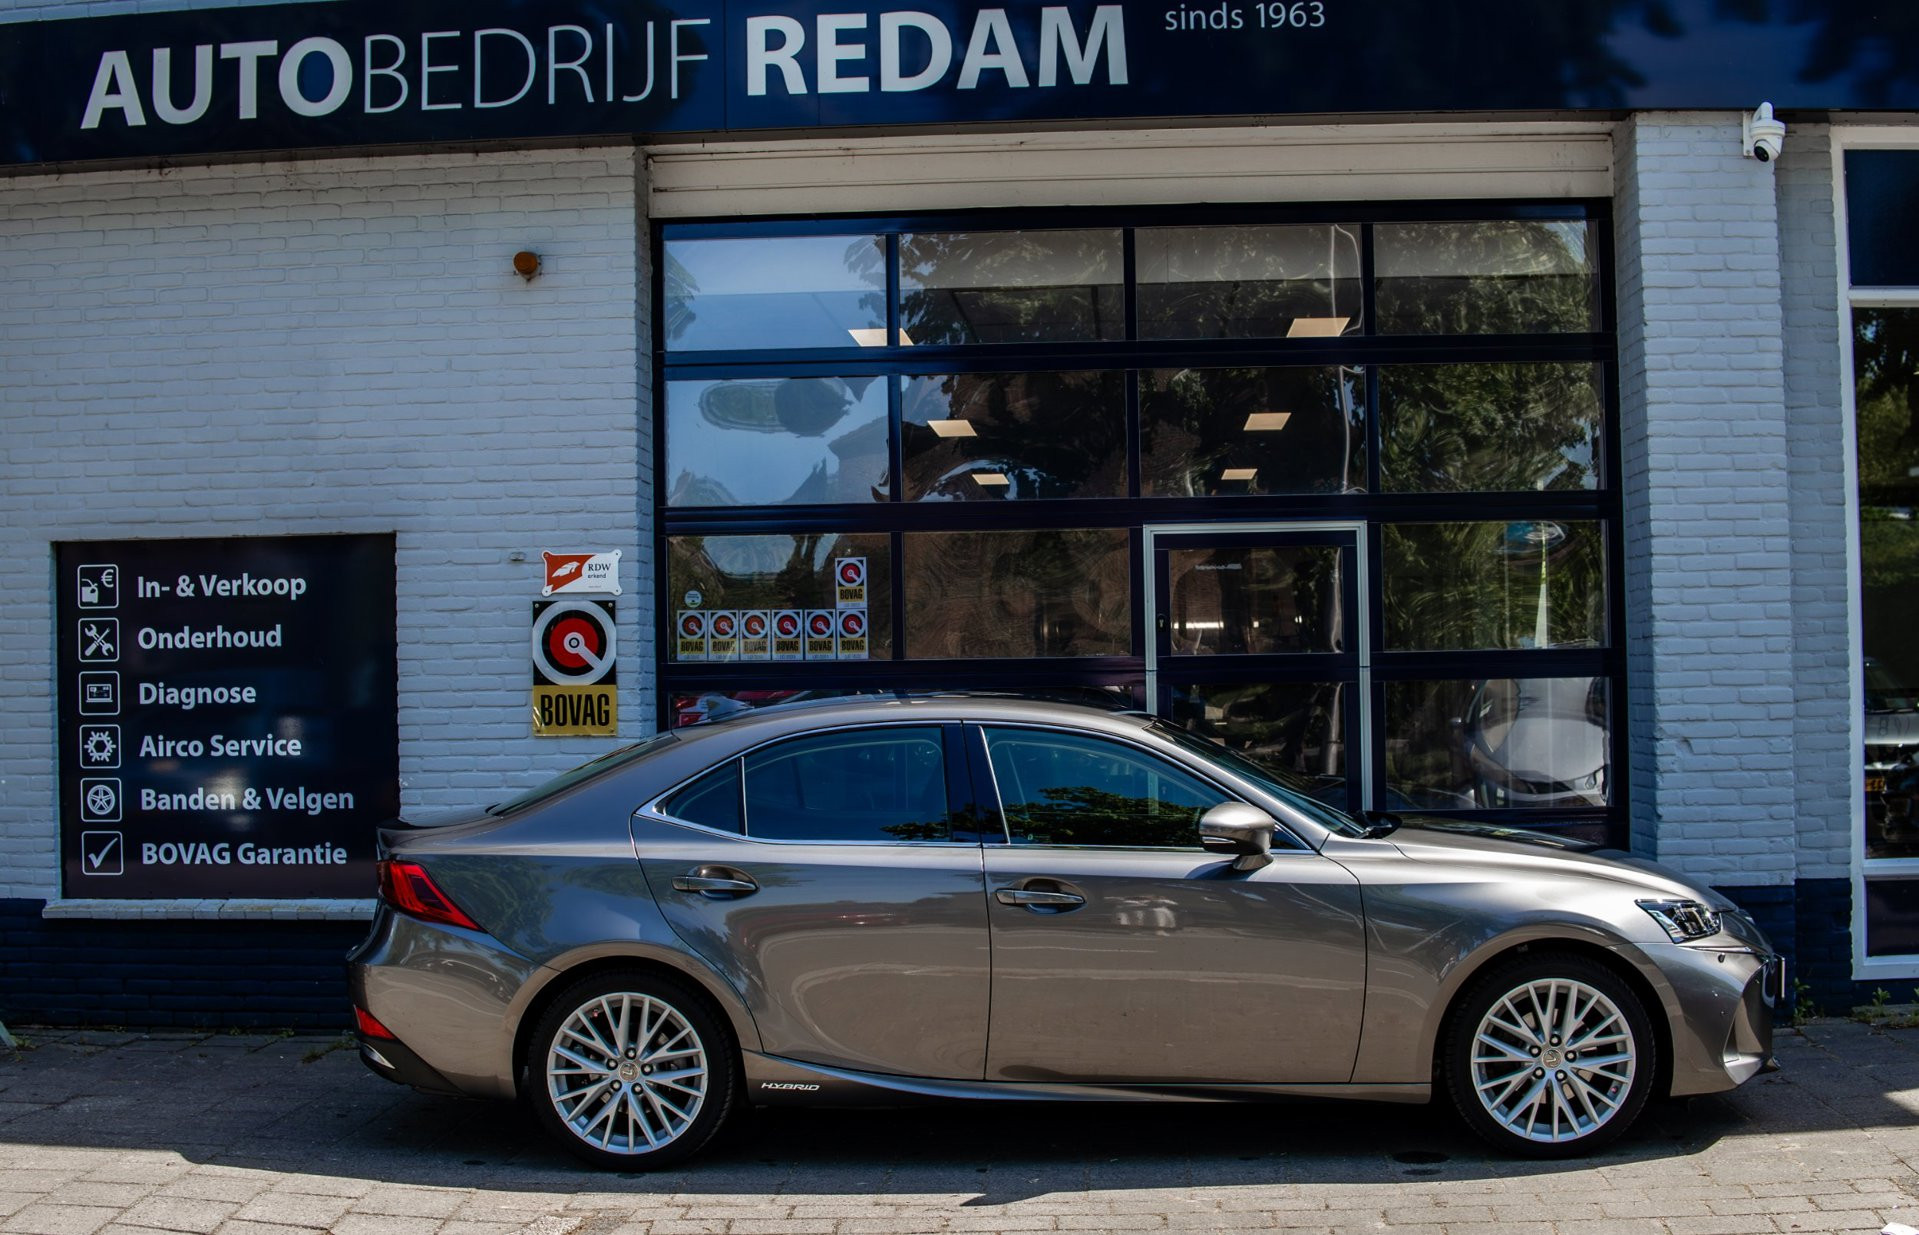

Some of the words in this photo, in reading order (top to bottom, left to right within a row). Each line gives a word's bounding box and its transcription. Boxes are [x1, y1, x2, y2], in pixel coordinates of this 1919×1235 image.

[1165, 2, 1244, 31] sinds
[1255, 1, 1326, 29] 1963
[747, 4, 1129, 97] REDAM
[587, 563, 612, 572] RDW
[137, 576, 170, 598] In-
[175, 575, 195, 598] &
[199, 573, 307, 601] Verkoop
[840, 588, 863, 600] BOVAG
[137, 624, 282, 650] Onderhoud
[809, 640, 832, 651] BOVAG
[841, 639, 864, 651] BOVAG
[139, 682, 257, 710] Diagnose
[540, 693, 610, 727] BOVAG
[139, 735, 204, 758] Airco
[210, 734, 302, 757] Service
[141, 787, 236, 811] Banden
[242, 787, 262, 810] &
[265, 786, 354, 816] Velgen
[142, 842, 231, 866] BOVAG
[237, 842, 348, 865] Garantie
[761, 1082, 820, 1091] HYBRID
